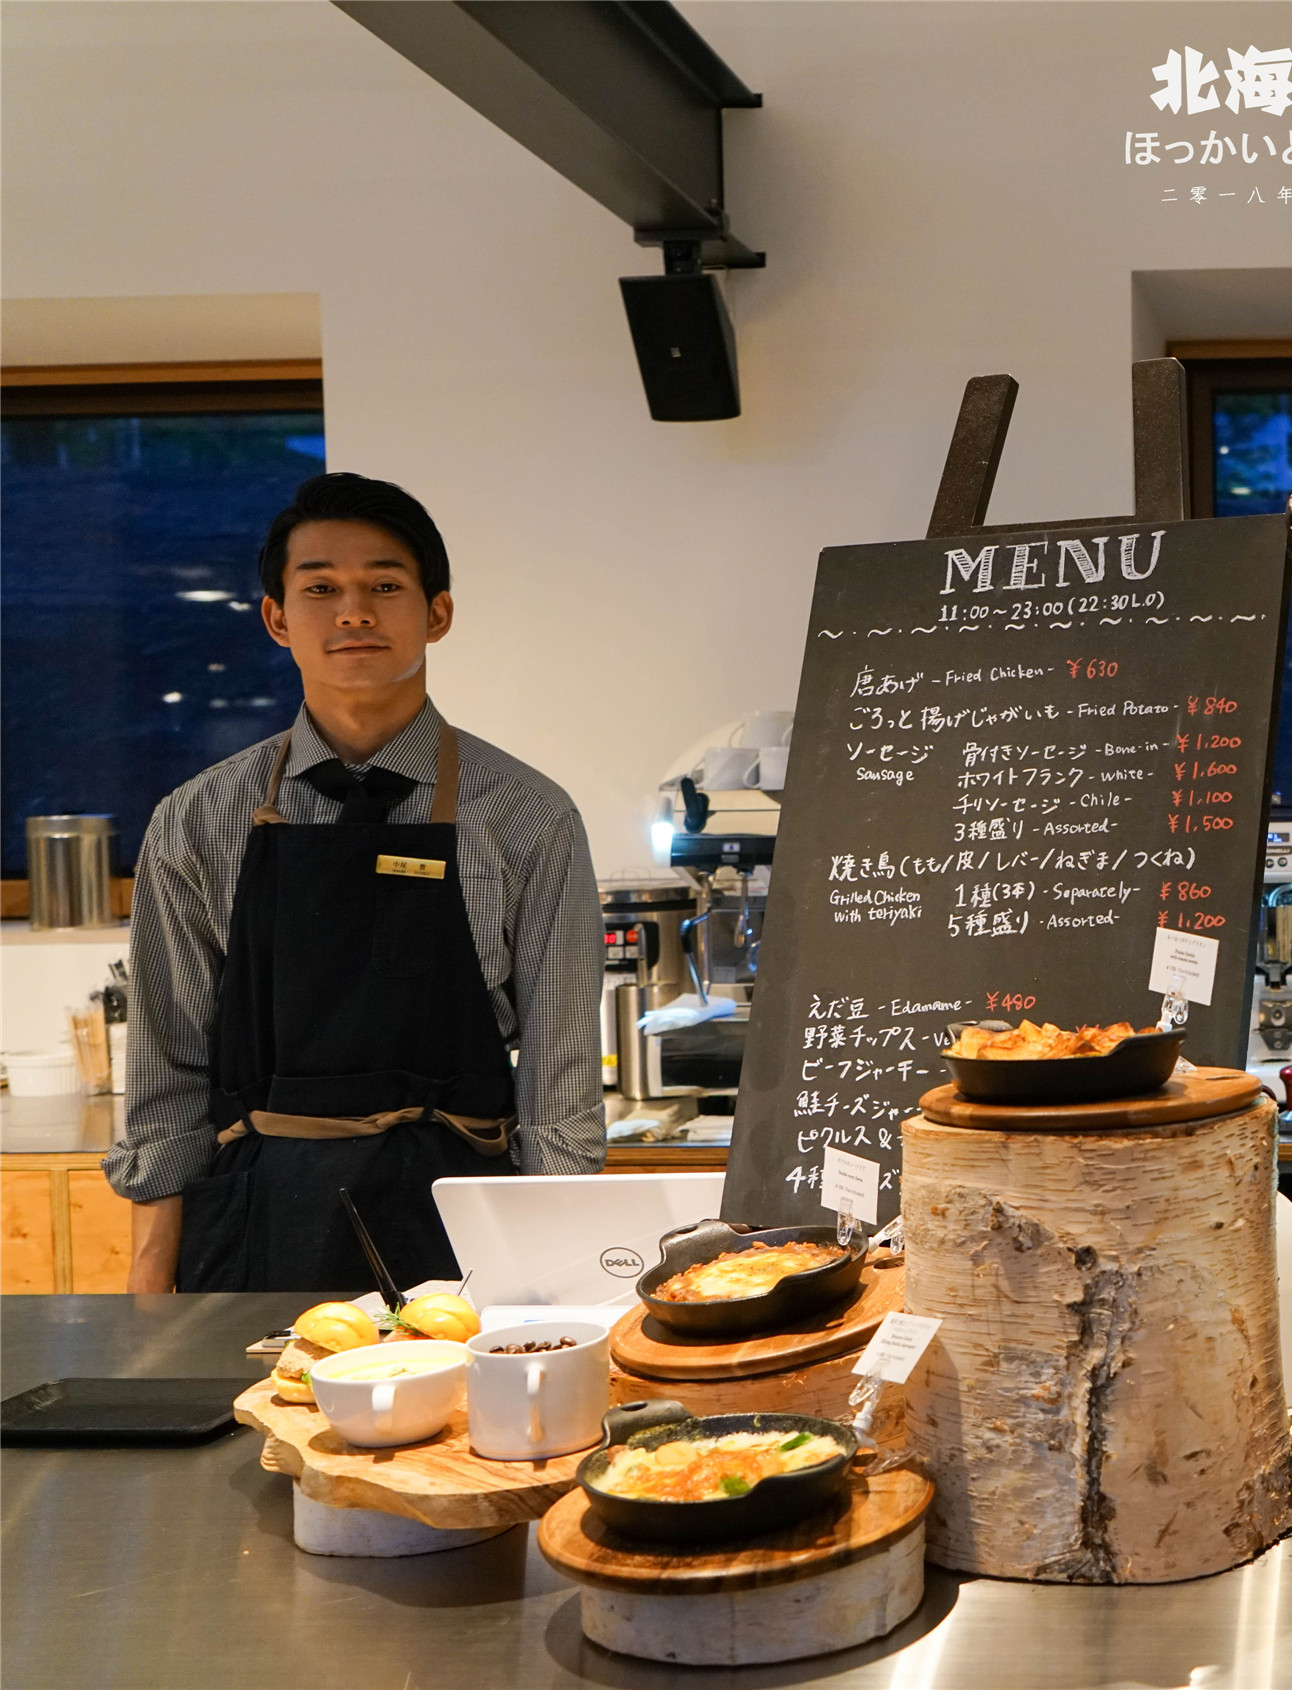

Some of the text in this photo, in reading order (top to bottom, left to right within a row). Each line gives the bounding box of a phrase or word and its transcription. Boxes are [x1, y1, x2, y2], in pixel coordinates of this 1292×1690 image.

[940, 530, 1167, 595] MENU
[850, 665, 924, 697] 唐あげ
[847, 742, 934, 764] ソーセージ
[963, 741, 1087, 767] 骨付きソーセージ
[957, 767, 1083, 789] ホワイトフランク
[952, 794, 1061, 815] チリソーセージ
[954, 817, 1024, 842] 3種盛り
[829, 886, 921, 906] Grilled Chicken
[834, 904, 922, 927] with teriyaki
[948, 908, 1029, 938] 5種盛り
[808, 994, 869, 1020] えだ豆
[802, 1023, 917, 1051] 野菜チップス
[605, 1258, 640, 1267] DELL
